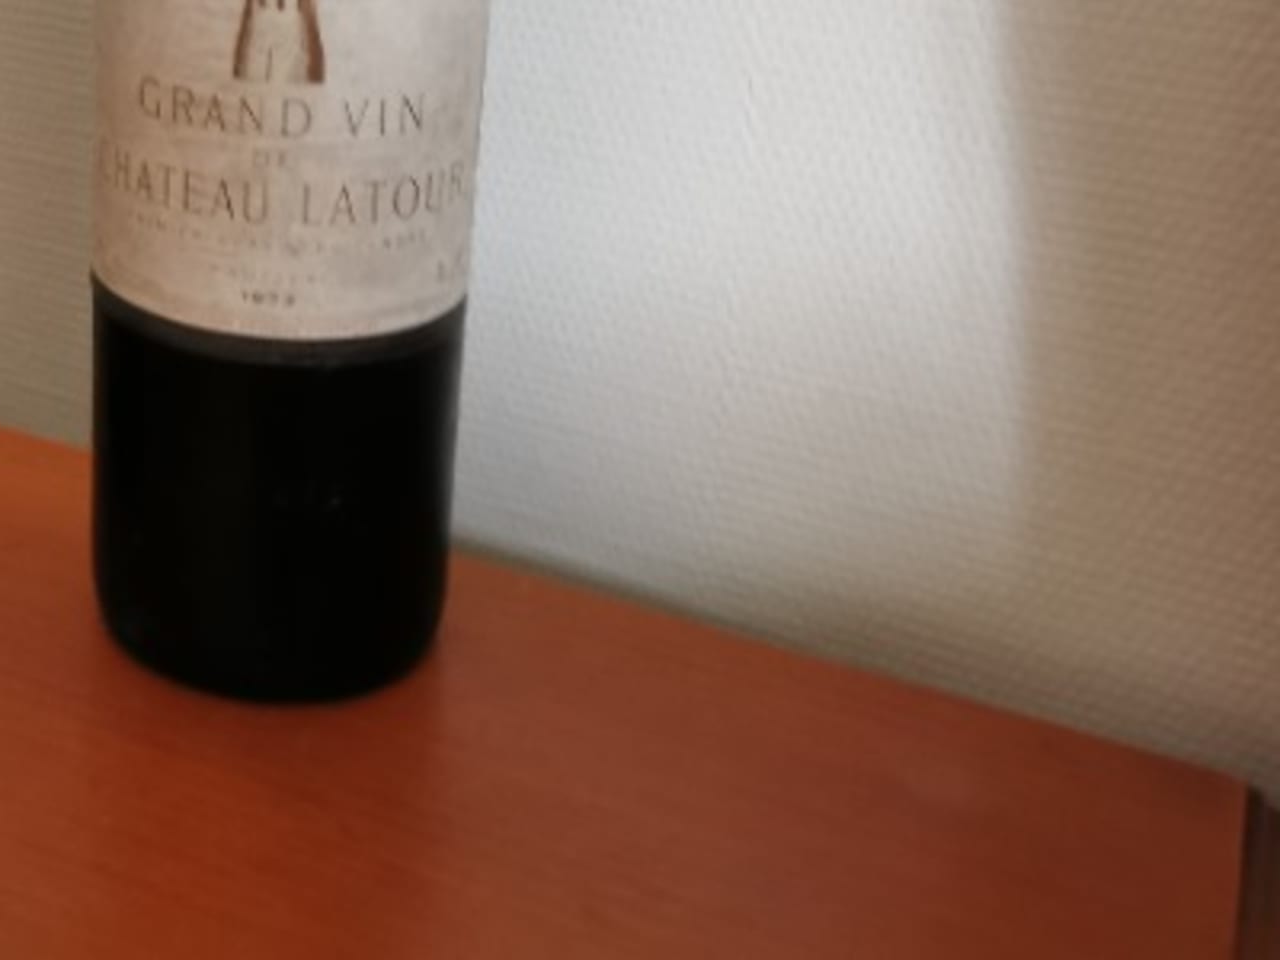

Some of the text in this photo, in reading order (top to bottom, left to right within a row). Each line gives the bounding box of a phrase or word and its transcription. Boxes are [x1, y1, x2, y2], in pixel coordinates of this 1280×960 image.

[138, 74, 424, 139] GRAND VIN
[301, 159, 465, 228] LATOUR
